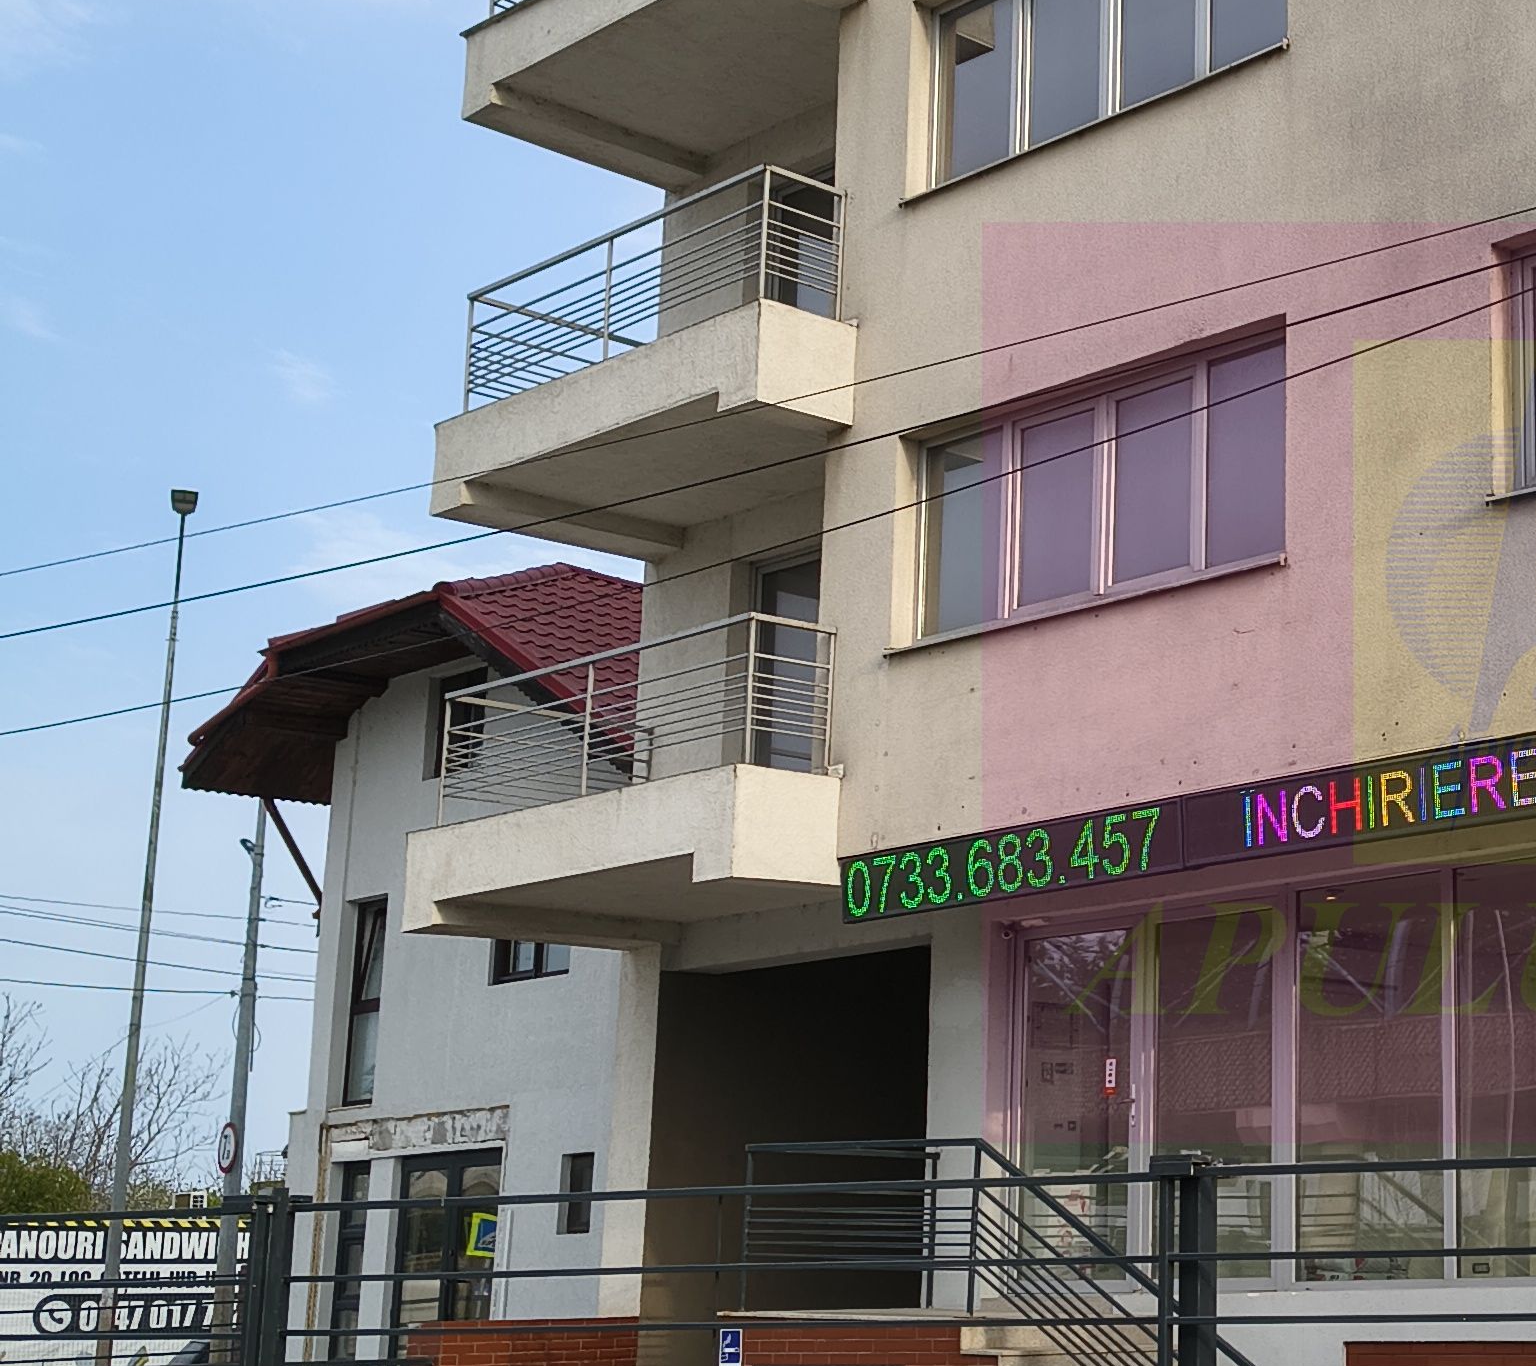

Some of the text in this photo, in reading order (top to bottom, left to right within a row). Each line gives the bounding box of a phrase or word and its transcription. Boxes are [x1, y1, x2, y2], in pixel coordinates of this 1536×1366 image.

[847, 808, 1160, 917] 0733.683.457
[0, 1230, 251, 1260] ANOURI ANDWIH
[79, 1299, 145, 1331] 047
